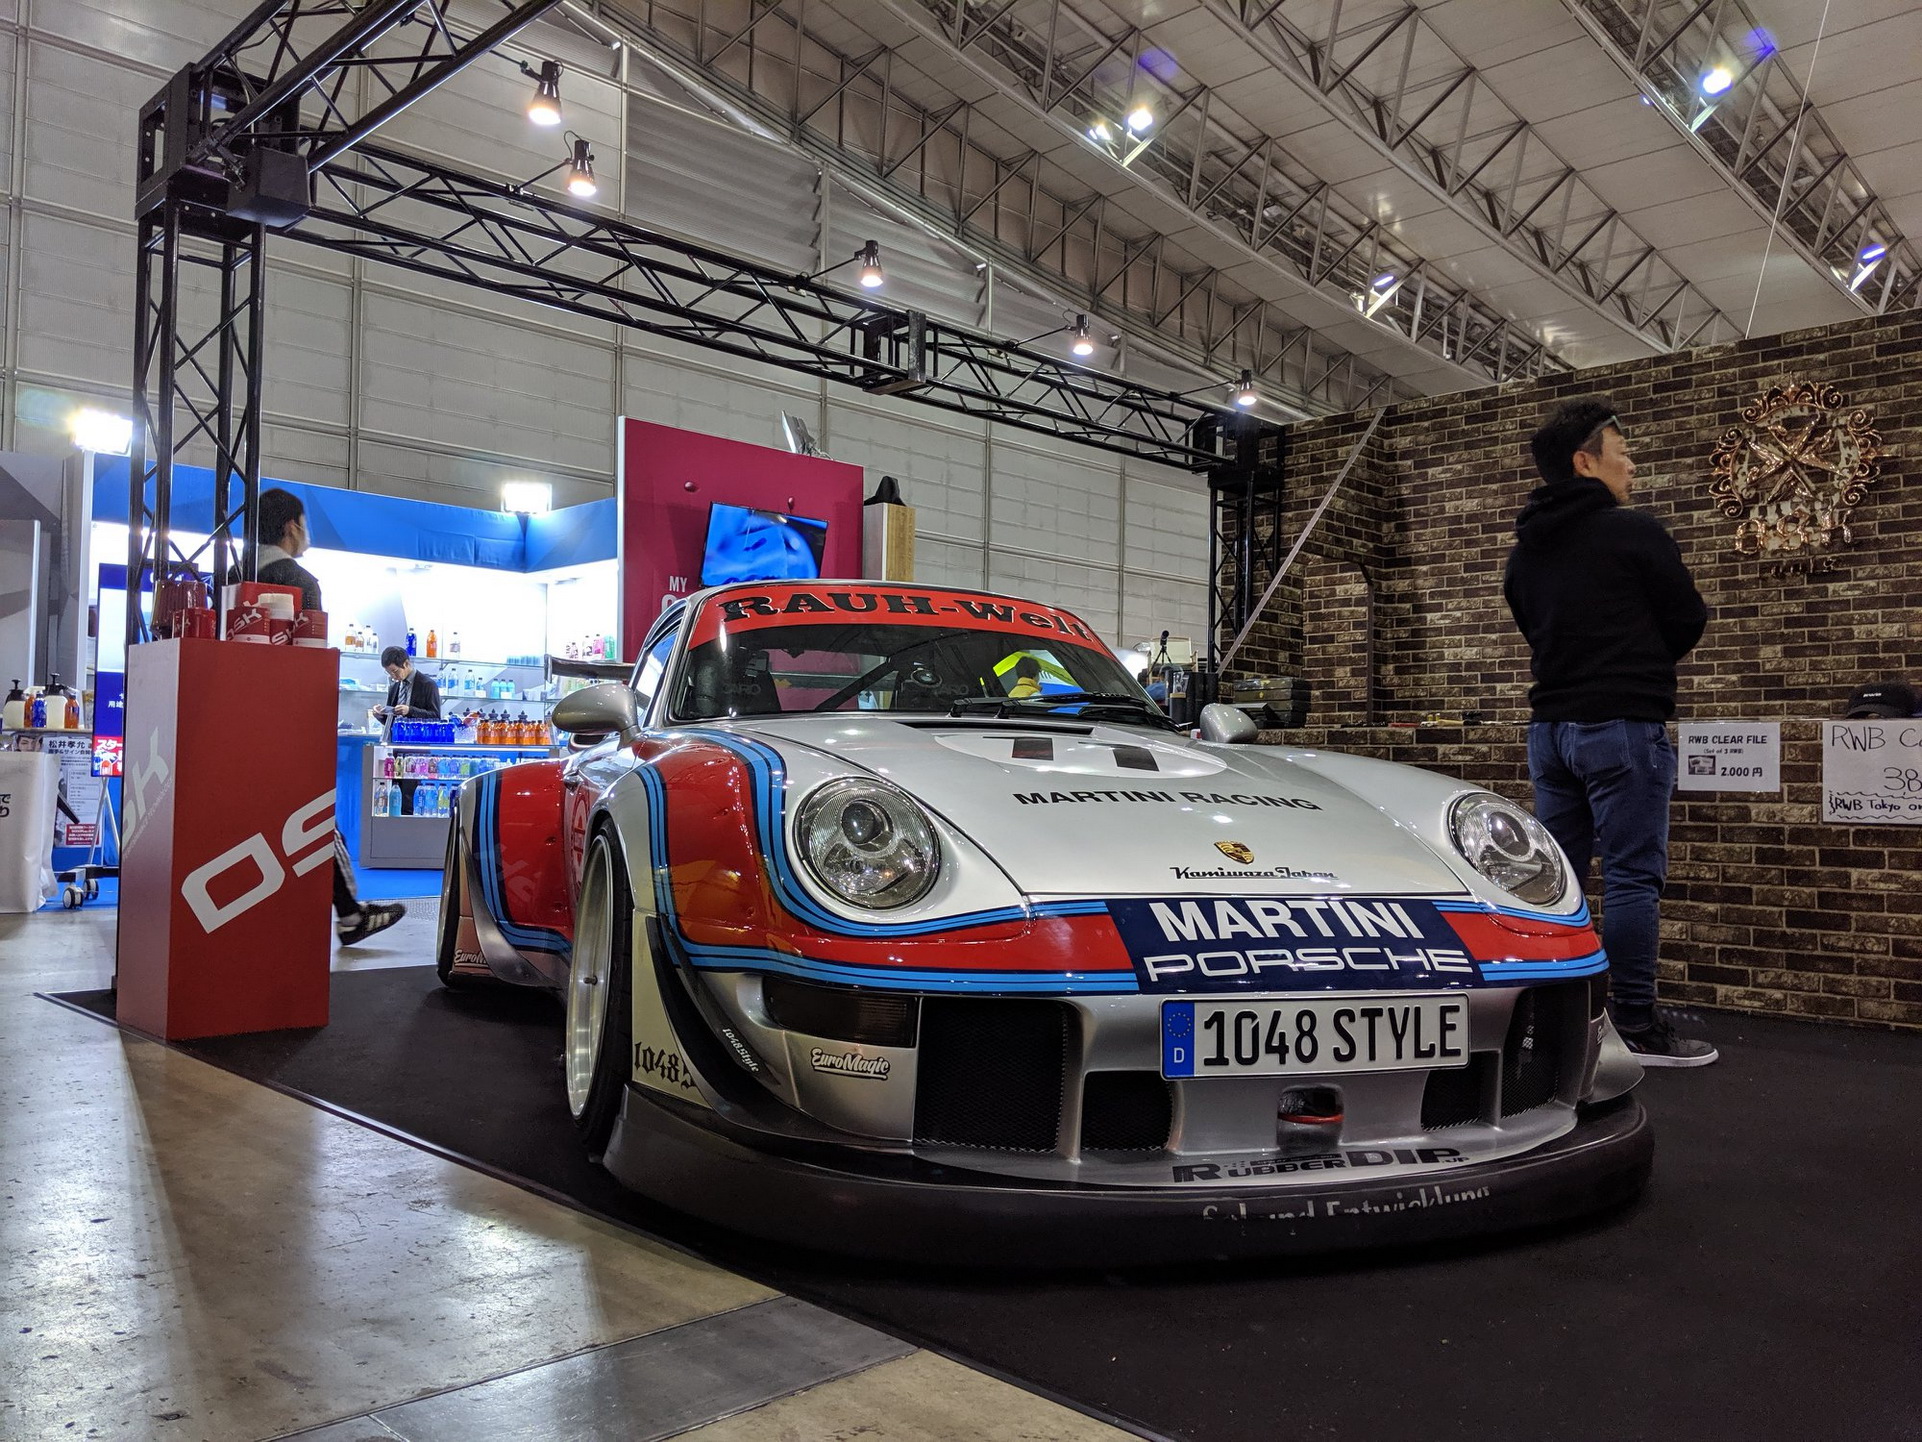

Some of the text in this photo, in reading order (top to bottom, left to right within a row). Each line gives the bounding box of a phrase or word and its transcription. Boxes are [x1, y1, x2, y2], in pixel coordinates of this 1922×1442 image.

[669, 575, 688, 593] MY
[718, 588, 1094, 643] RAUH-Welt
[1688, 735, 1767, 745] RWB CLEAR FILE
[1832, 725, 1886, 752] RWB
[1751, 767, 1763, 778] 円
[1012, 790, 1324, 811] MARTINI RACING
[1834, 797, 1863, 811] RWB
[1869, 798, 1901, 812] Tokyo
[1169, 866, 1338, 880] Kamiwaza Japan
[1149, 900, 1425, 942] MARTINI
[1143, 948, 1474, 982] PORSCHE
[1173, 1004, 1462, 1066] D 1048 STYLE
[810, 1046, 891, 1079] EuroMagic
